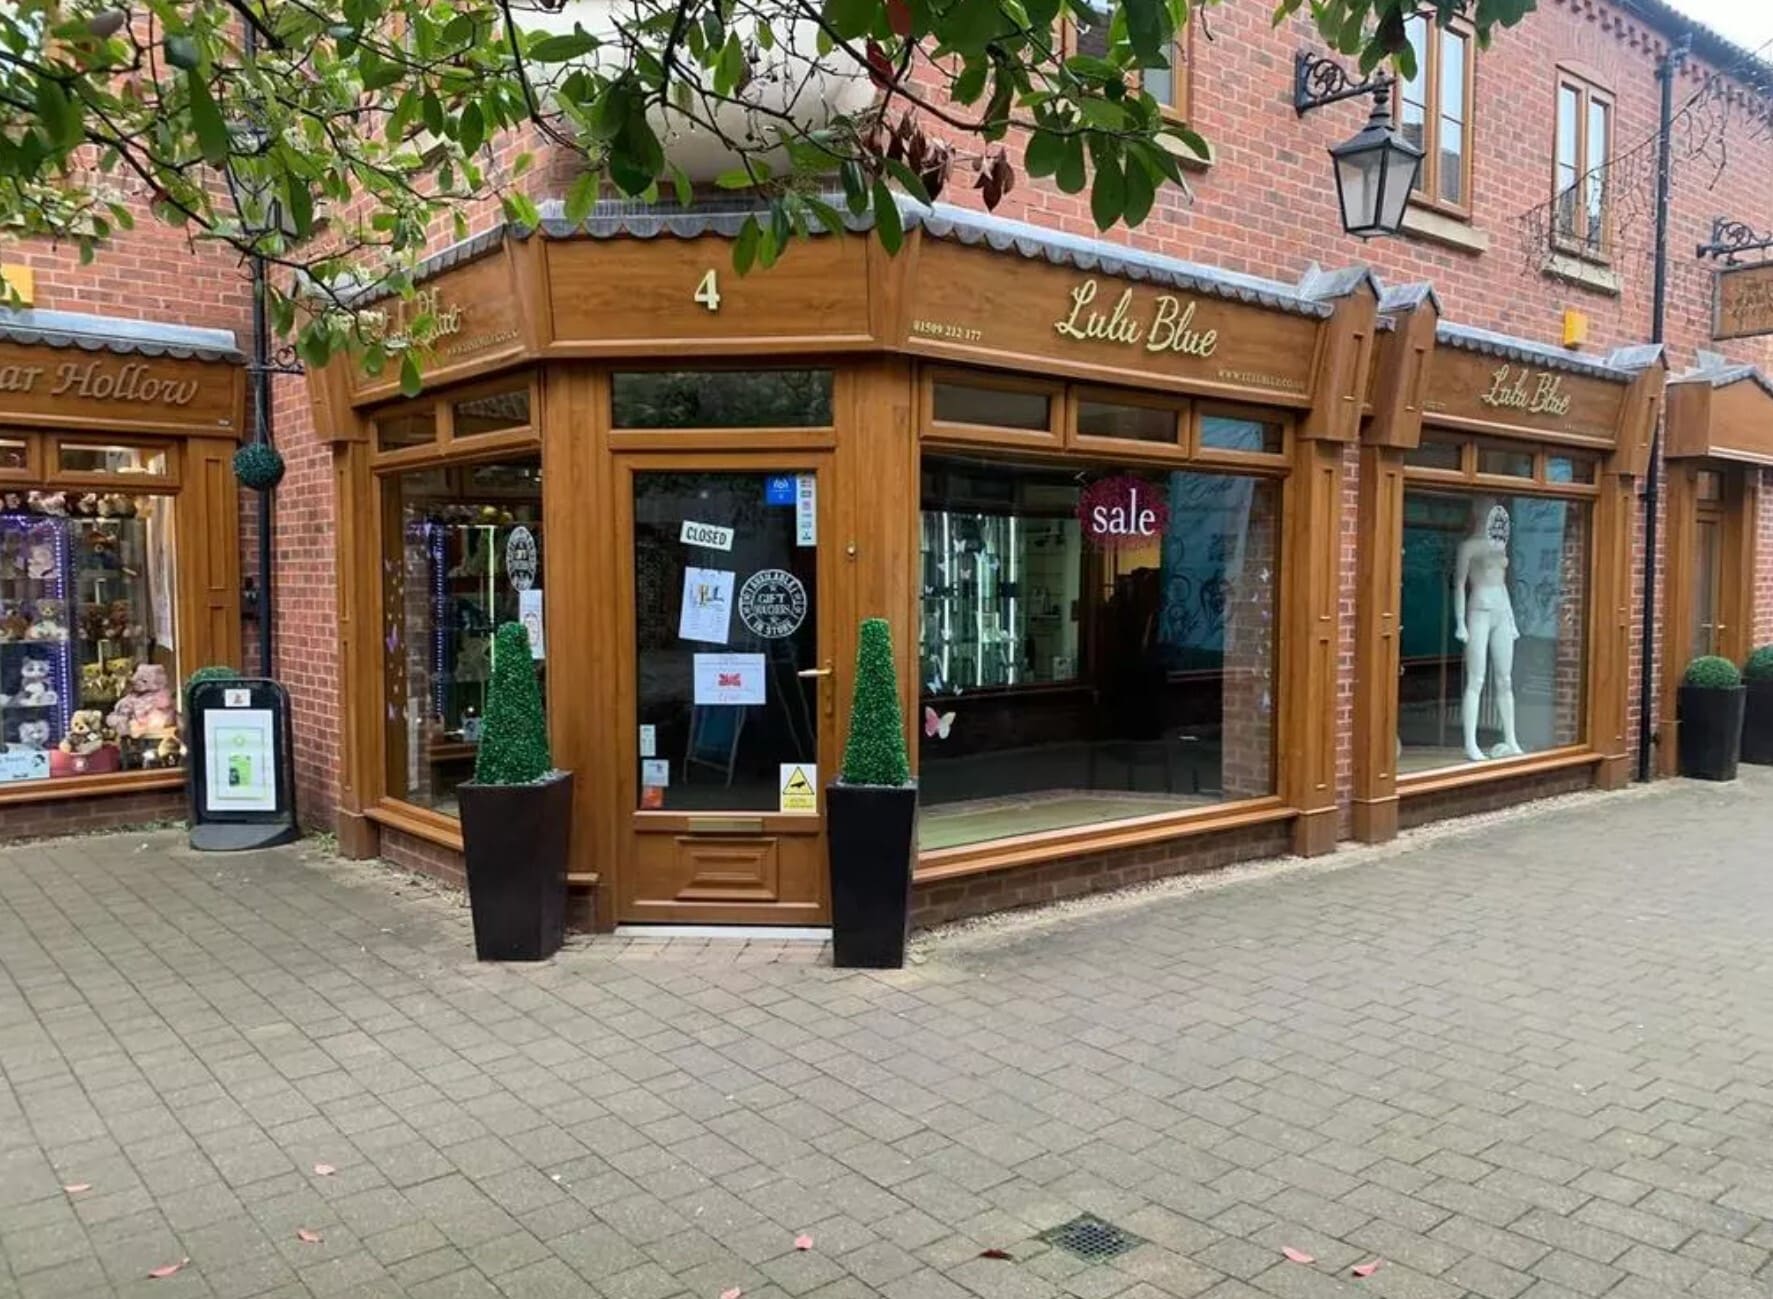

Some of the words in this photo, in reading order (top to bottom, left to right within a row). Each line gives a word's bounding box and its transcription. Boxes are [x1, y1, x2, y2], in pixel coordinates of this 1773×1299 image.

[694, 269, 720, 310] 4
[1054, 279, 1143, 344] Lulu
[1146, 295, 1217, 357] Blue
[51, 361, 198, 405] Hollow
[1480, 364, 1529, 408] Lulu
[1528, 372, 1571, 416] Blue
[1092, 487, 1157, 535] sale
[686, 526, 727, 546] CLOSED
[757, 593, 786, 604] GIFT
